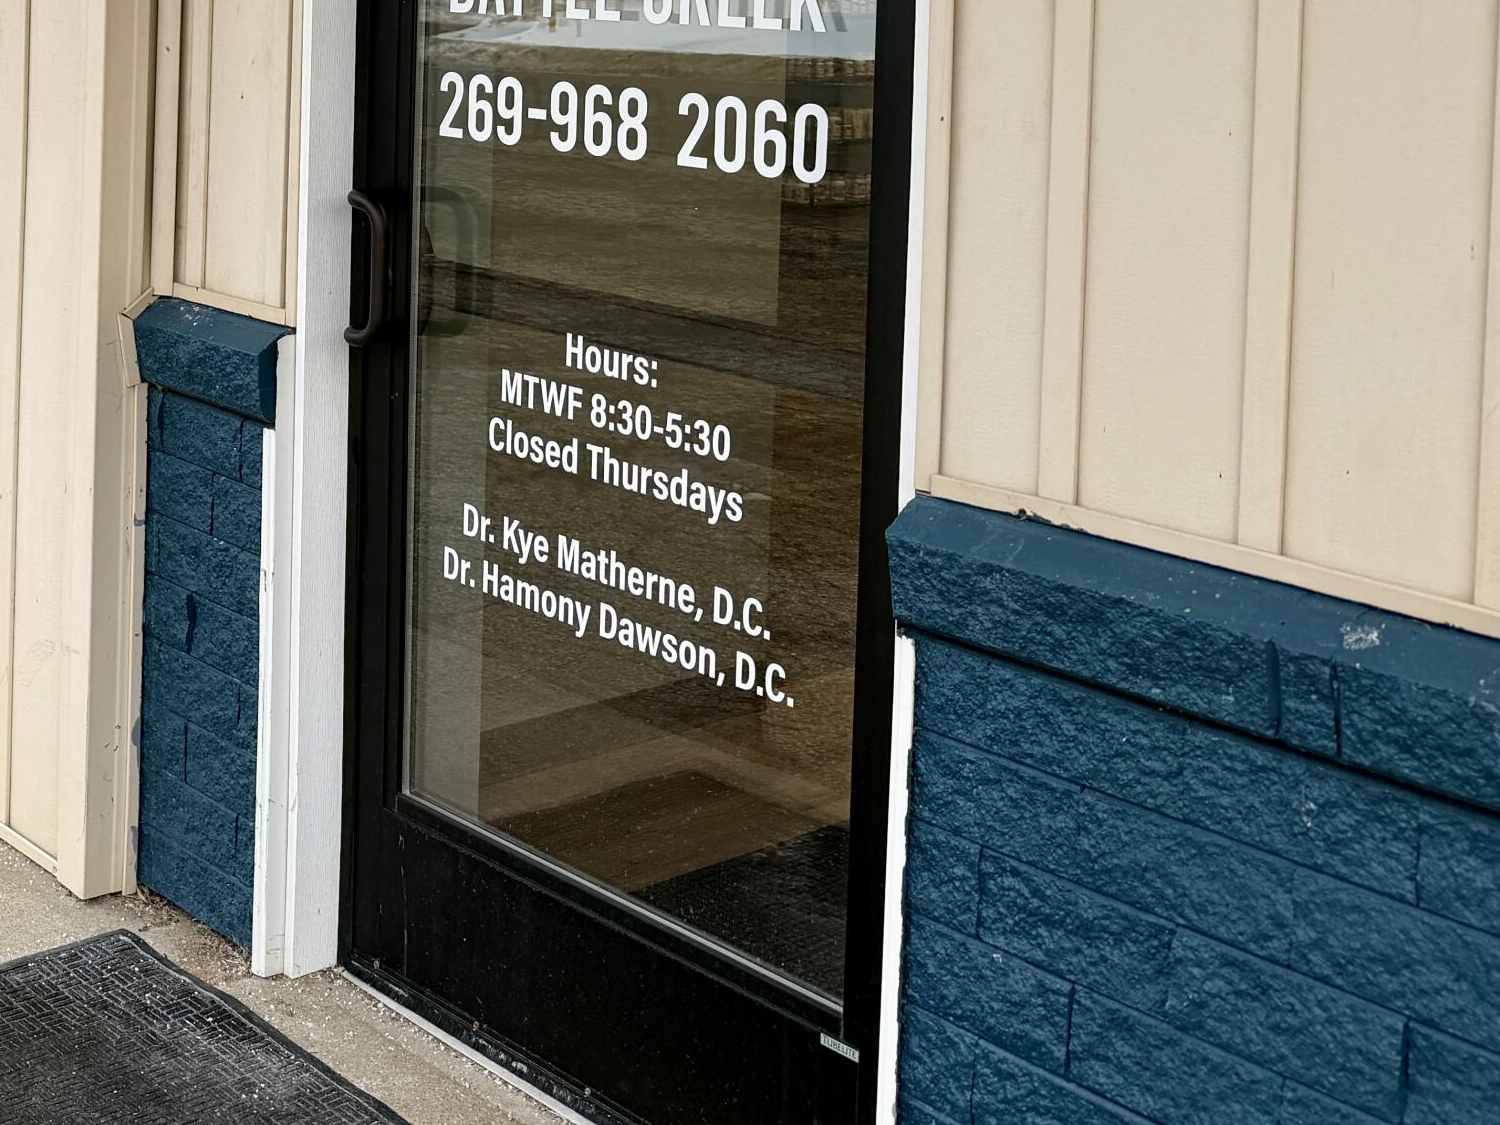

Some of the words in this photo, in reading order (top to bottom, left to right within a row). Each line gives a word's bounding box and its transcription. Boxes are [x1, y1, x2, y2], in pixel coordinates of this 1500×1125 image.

[438, 70, 649, 162] 269-968
[676, 91, 829, 184] 2060
[500, 368, 583, 421] MTWF
[590, 393, 731, 462] 8:30-5:30
[565, 331, 658, 388] Hours:
[488, 416, 579, 475] Closed
[586, 442, 744, 525] Thursdays
[443, 545, 476, 588] Dr.
[482, 559, 592, 638] Hamony
[599, 602, 726, 687] Dawson,
[735, 649, 795, 708] D.C.
[463, 502, 496, 544] Dr.
[502, 515, 549, 565] Kye
[557, 533, 704, 623] Matherne,
[713, 585, 771, 641] D.C.
